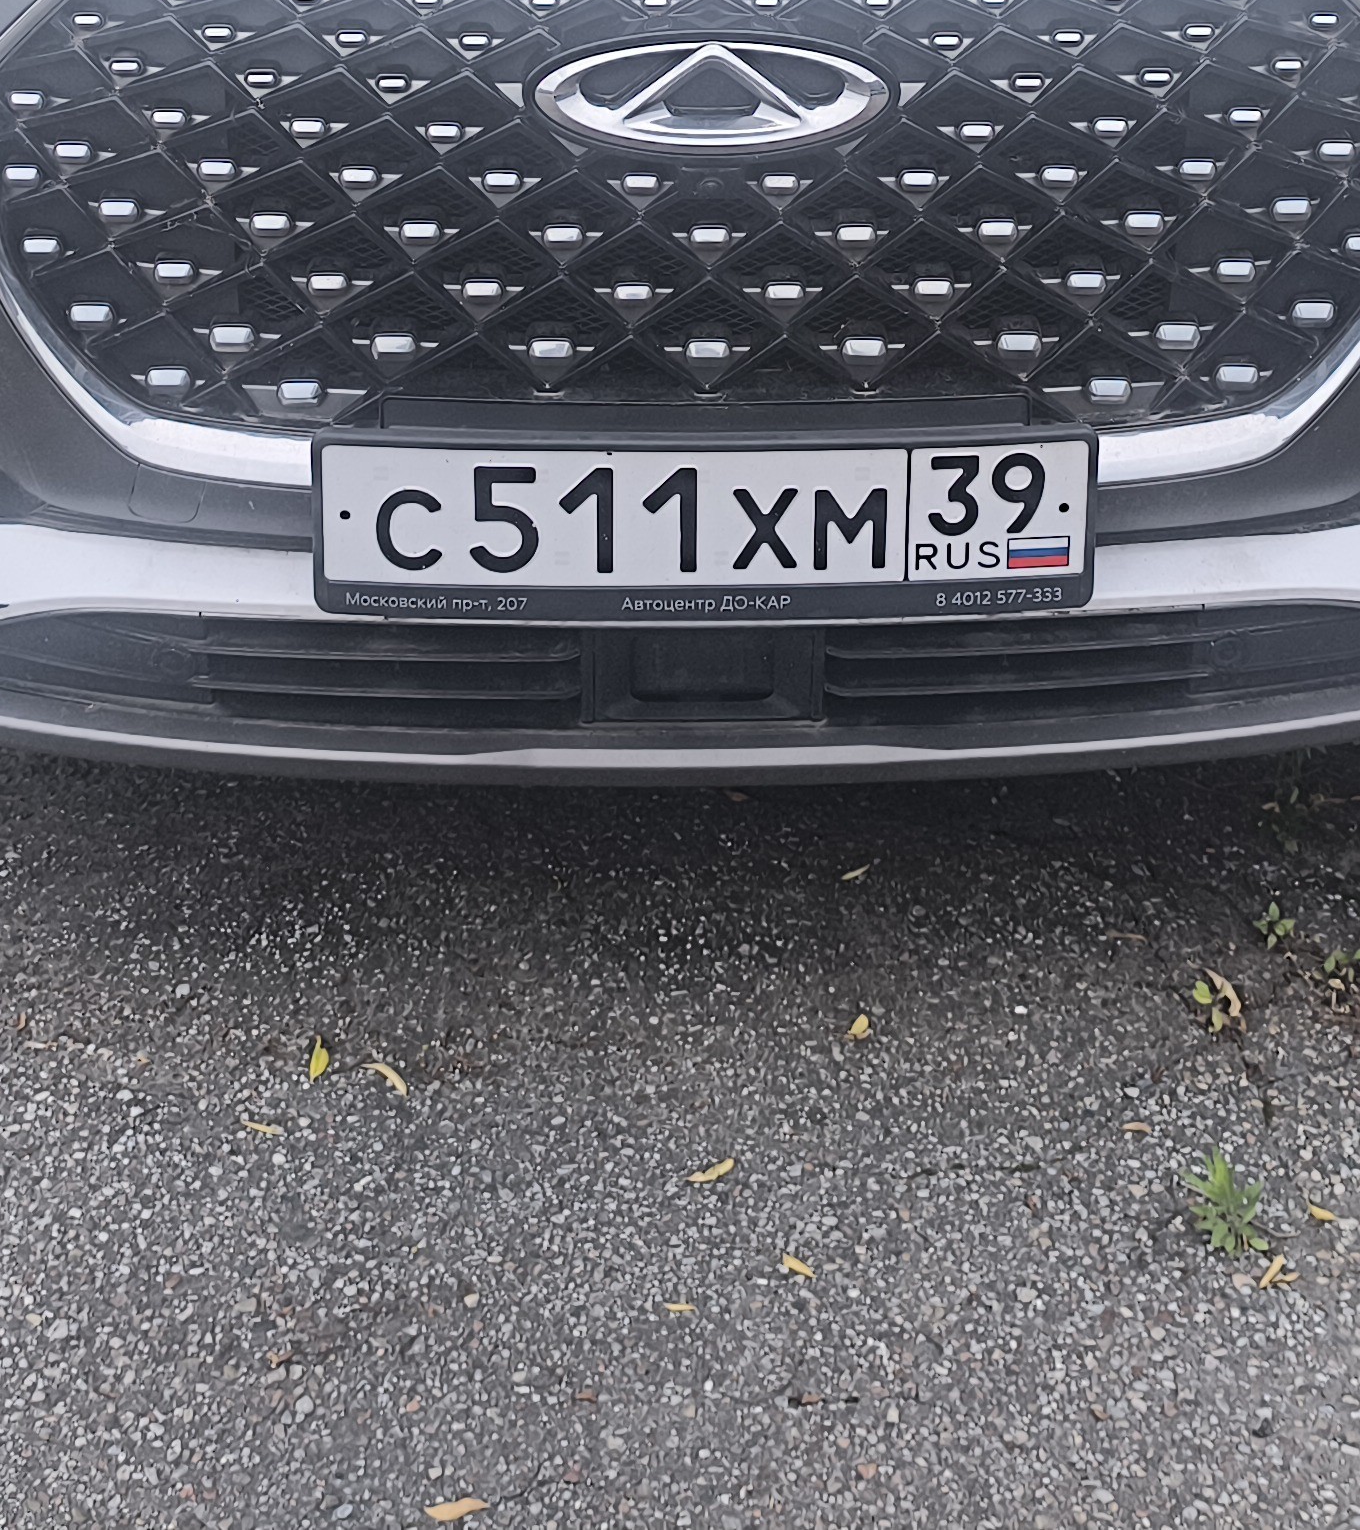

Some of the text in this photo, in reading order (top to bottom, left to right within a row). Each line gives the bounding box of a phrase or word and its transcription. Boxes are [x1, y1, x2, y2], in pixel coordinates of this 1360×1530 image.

[927, 452, 1046, 537] 39
[914, 541, 1001, 571] RUS
[345, 591, 528, 613] Московский пр-т, 207
[621, 595, 792, 613] Автоцентр ДО-КАР
[935, 587, 1063, 607] 8 4012 577-333
